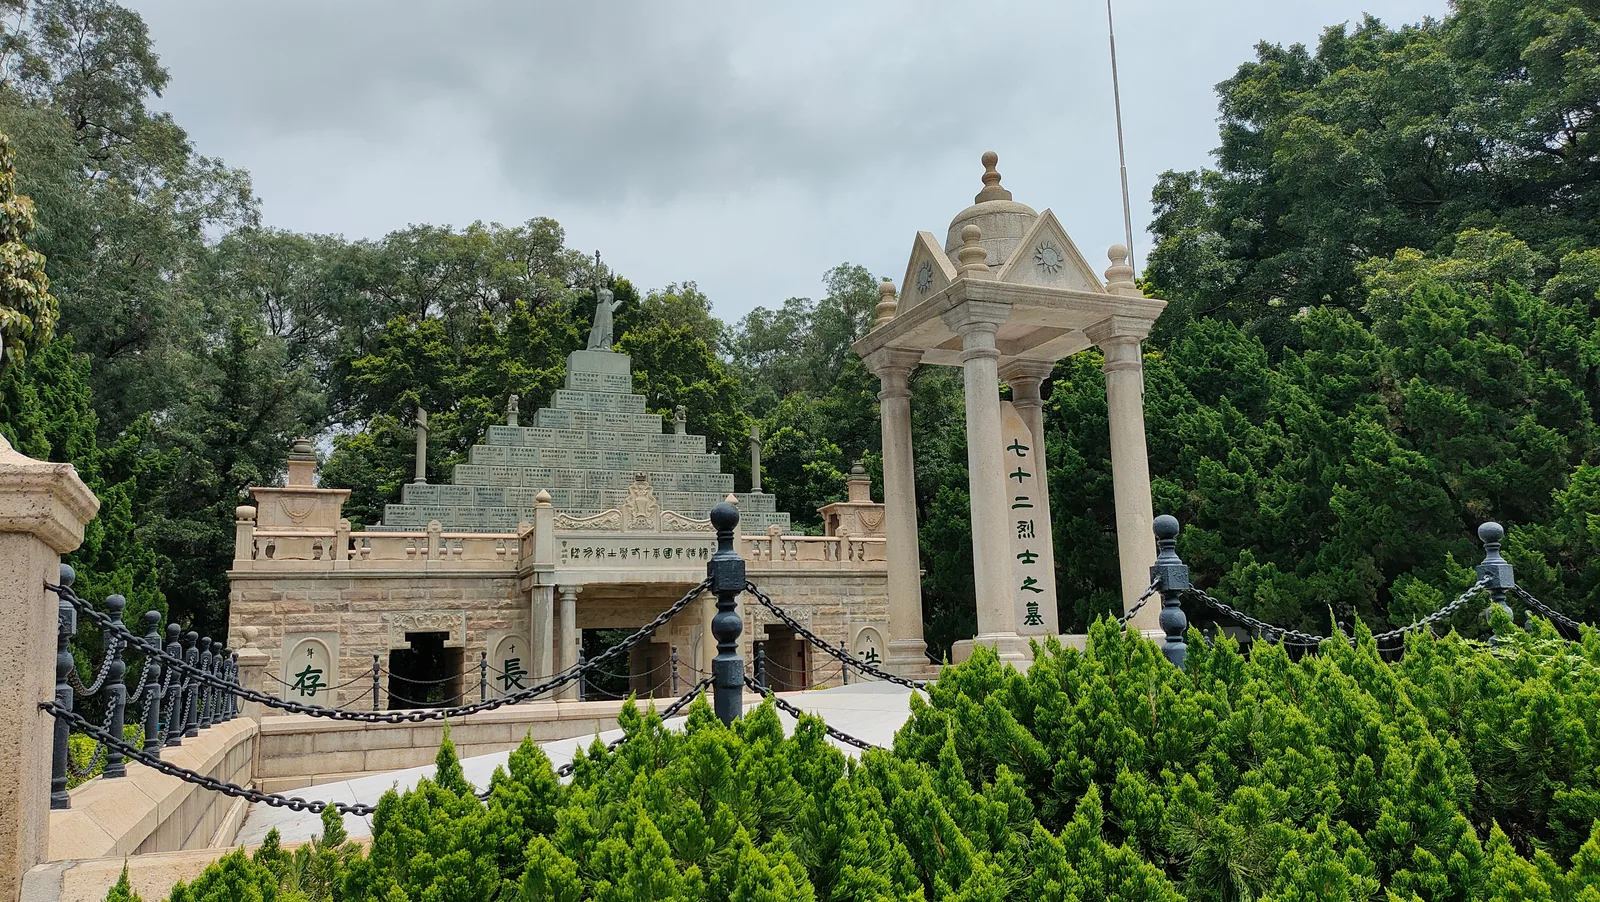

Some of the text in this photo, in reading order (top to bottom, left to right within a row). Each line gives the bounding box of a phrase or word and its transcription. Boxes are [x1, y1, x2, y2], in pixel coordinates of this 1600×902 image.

[1006, 438, 1044, 626] 七十二烈士之墓
[290, 664, 327, 698] 存
[495, 657, 529, 692] 長
